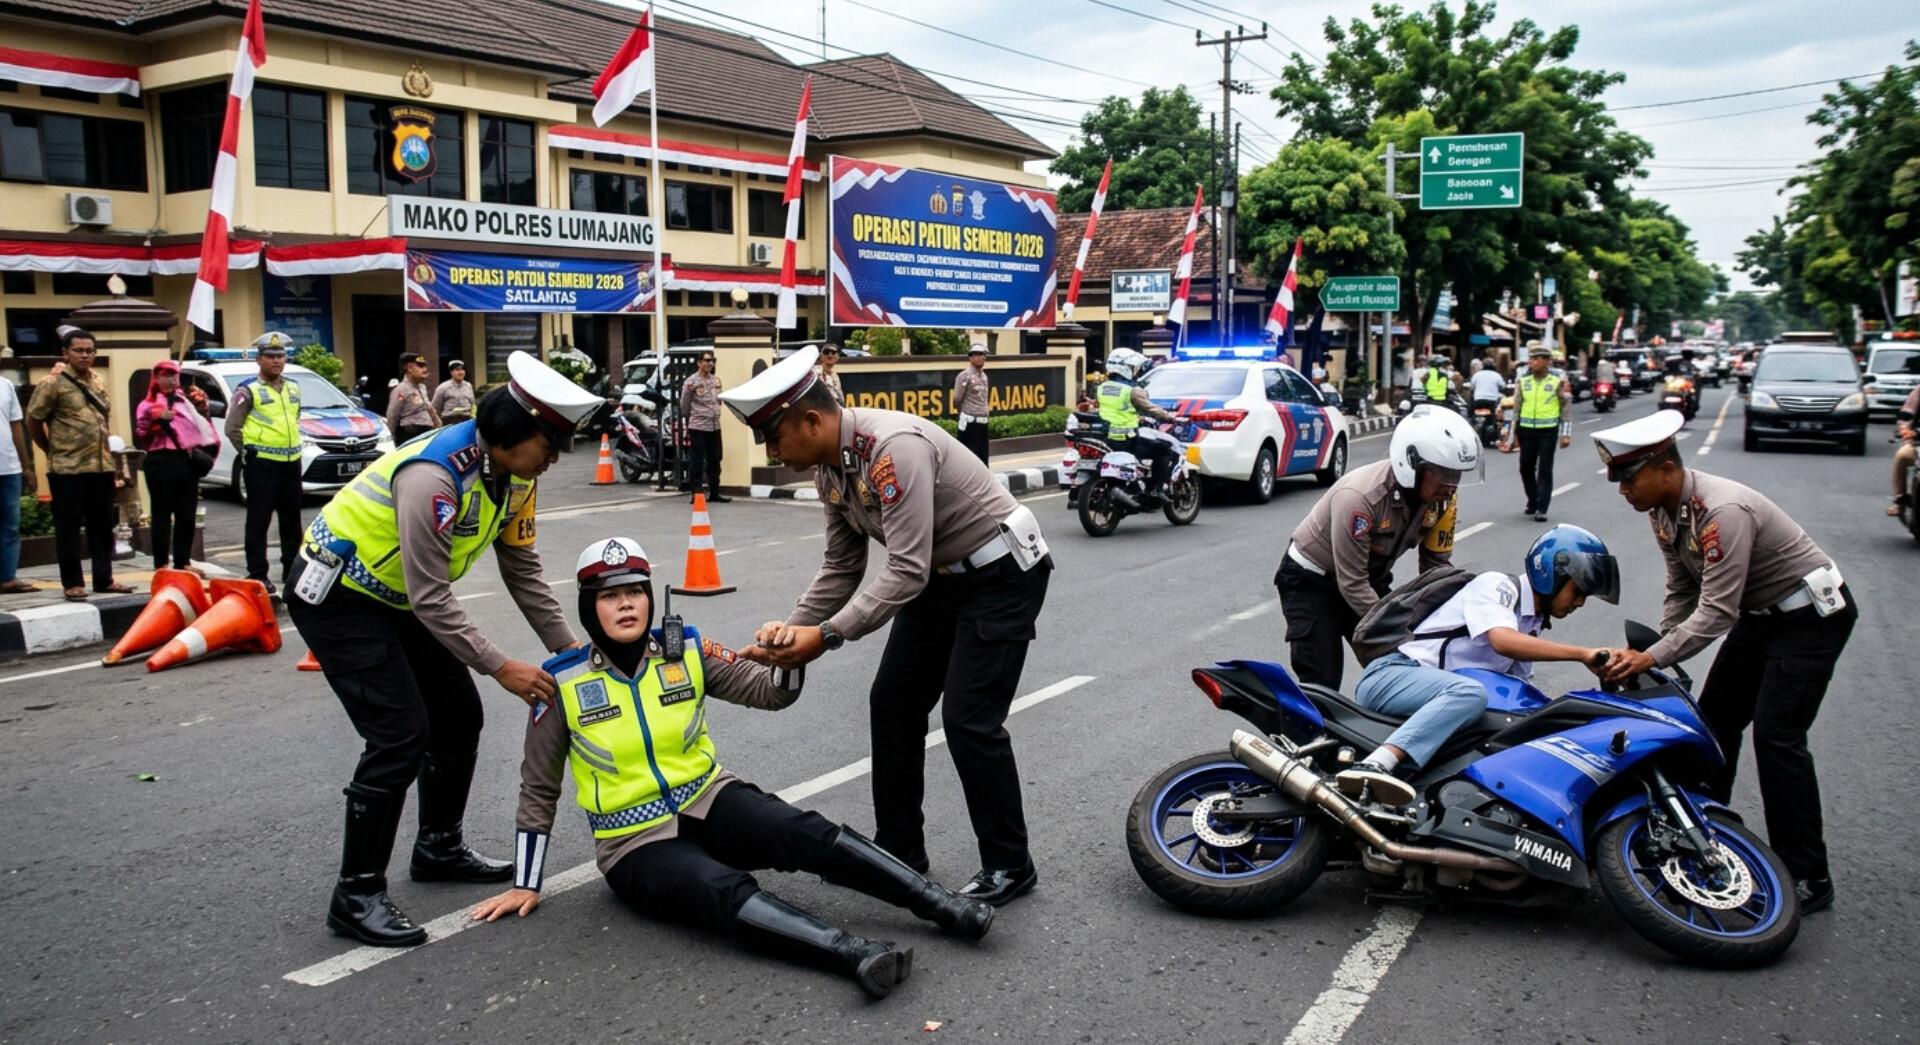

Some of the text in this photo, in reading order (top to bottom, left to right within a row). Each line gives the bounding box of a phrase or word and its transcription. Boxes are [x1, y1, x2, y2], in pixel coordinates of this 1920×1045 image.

[403, 203, 655, 246] MAKO POLRES LUMAJANG
[853, 214, 915, 246] OPERASI
[918, 221, 961, 250] PATUH
[505, 289, 577, 304] SATLANTAS
